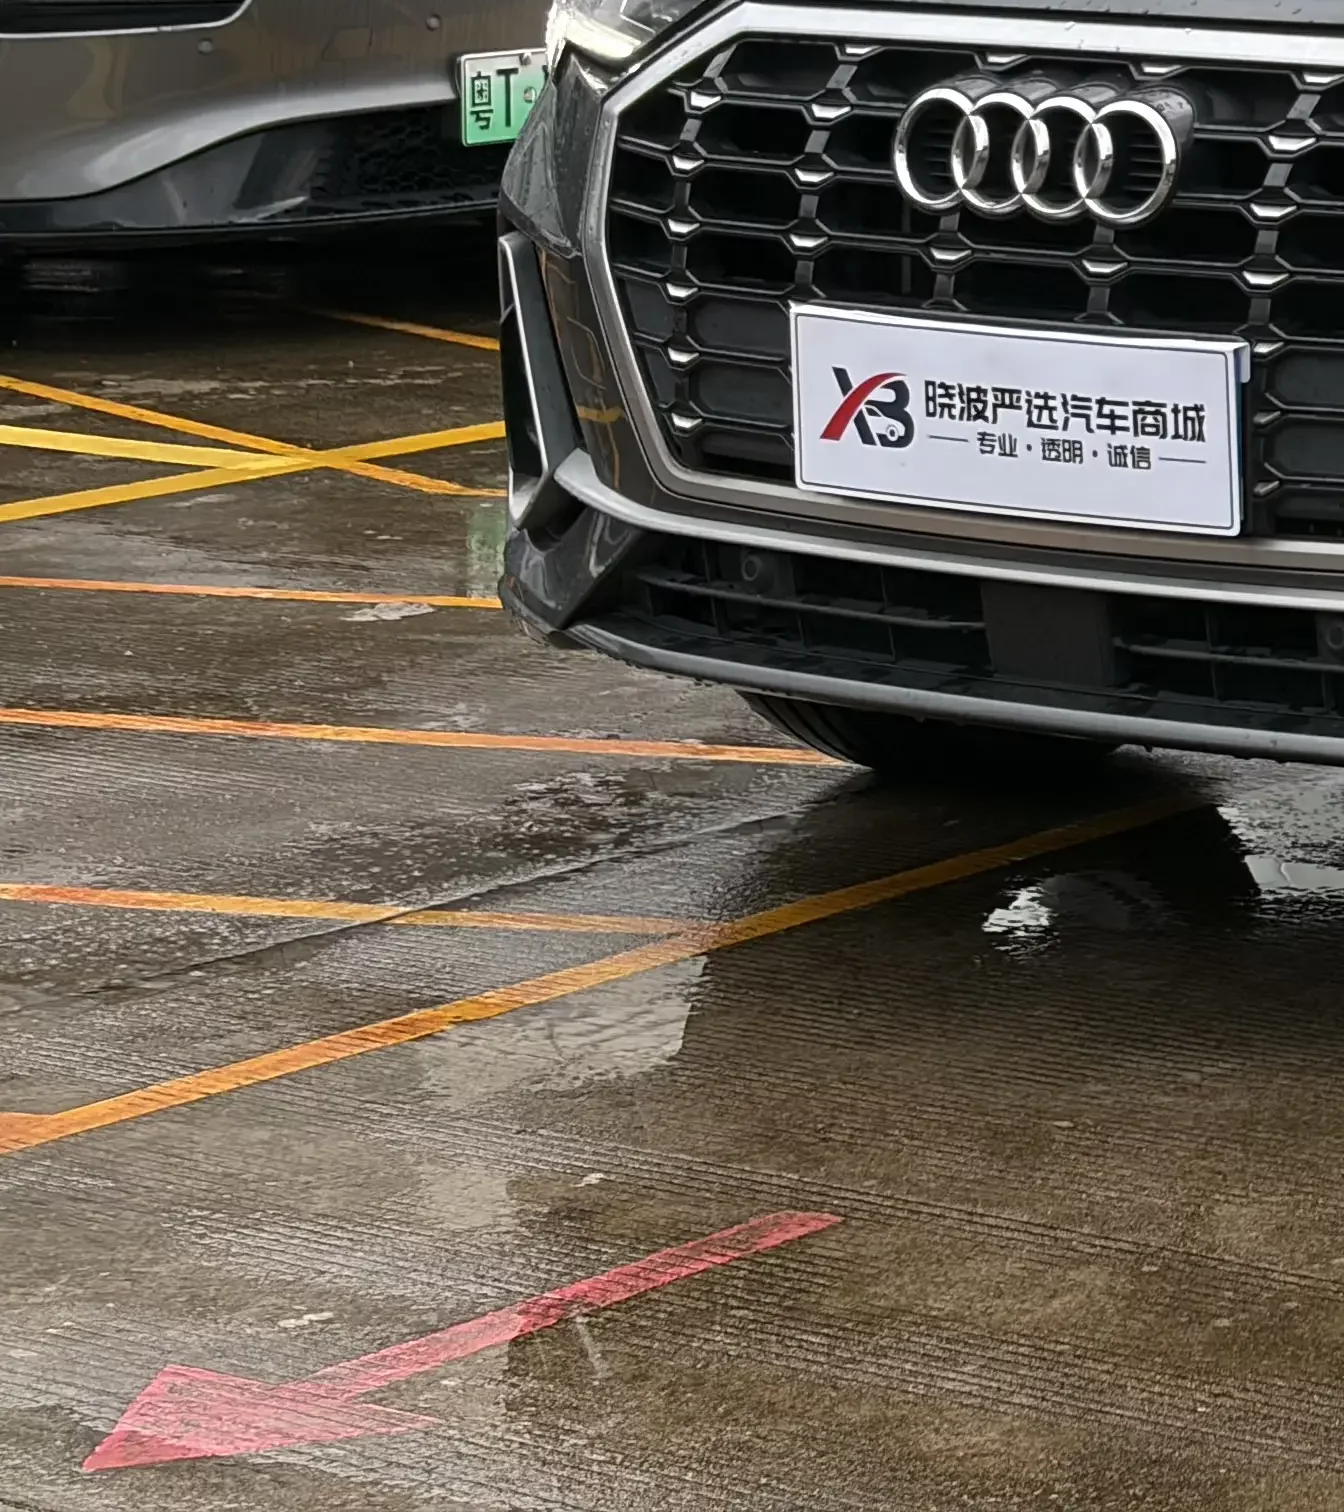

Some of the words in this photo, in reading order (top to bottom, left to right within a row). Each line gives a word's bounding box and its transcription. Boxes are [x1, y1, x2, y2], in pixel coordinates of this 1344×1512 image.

[469, 65, 550, 131] 粤T
[923, 378, 1207, 444] 晓波严选汽车商城
